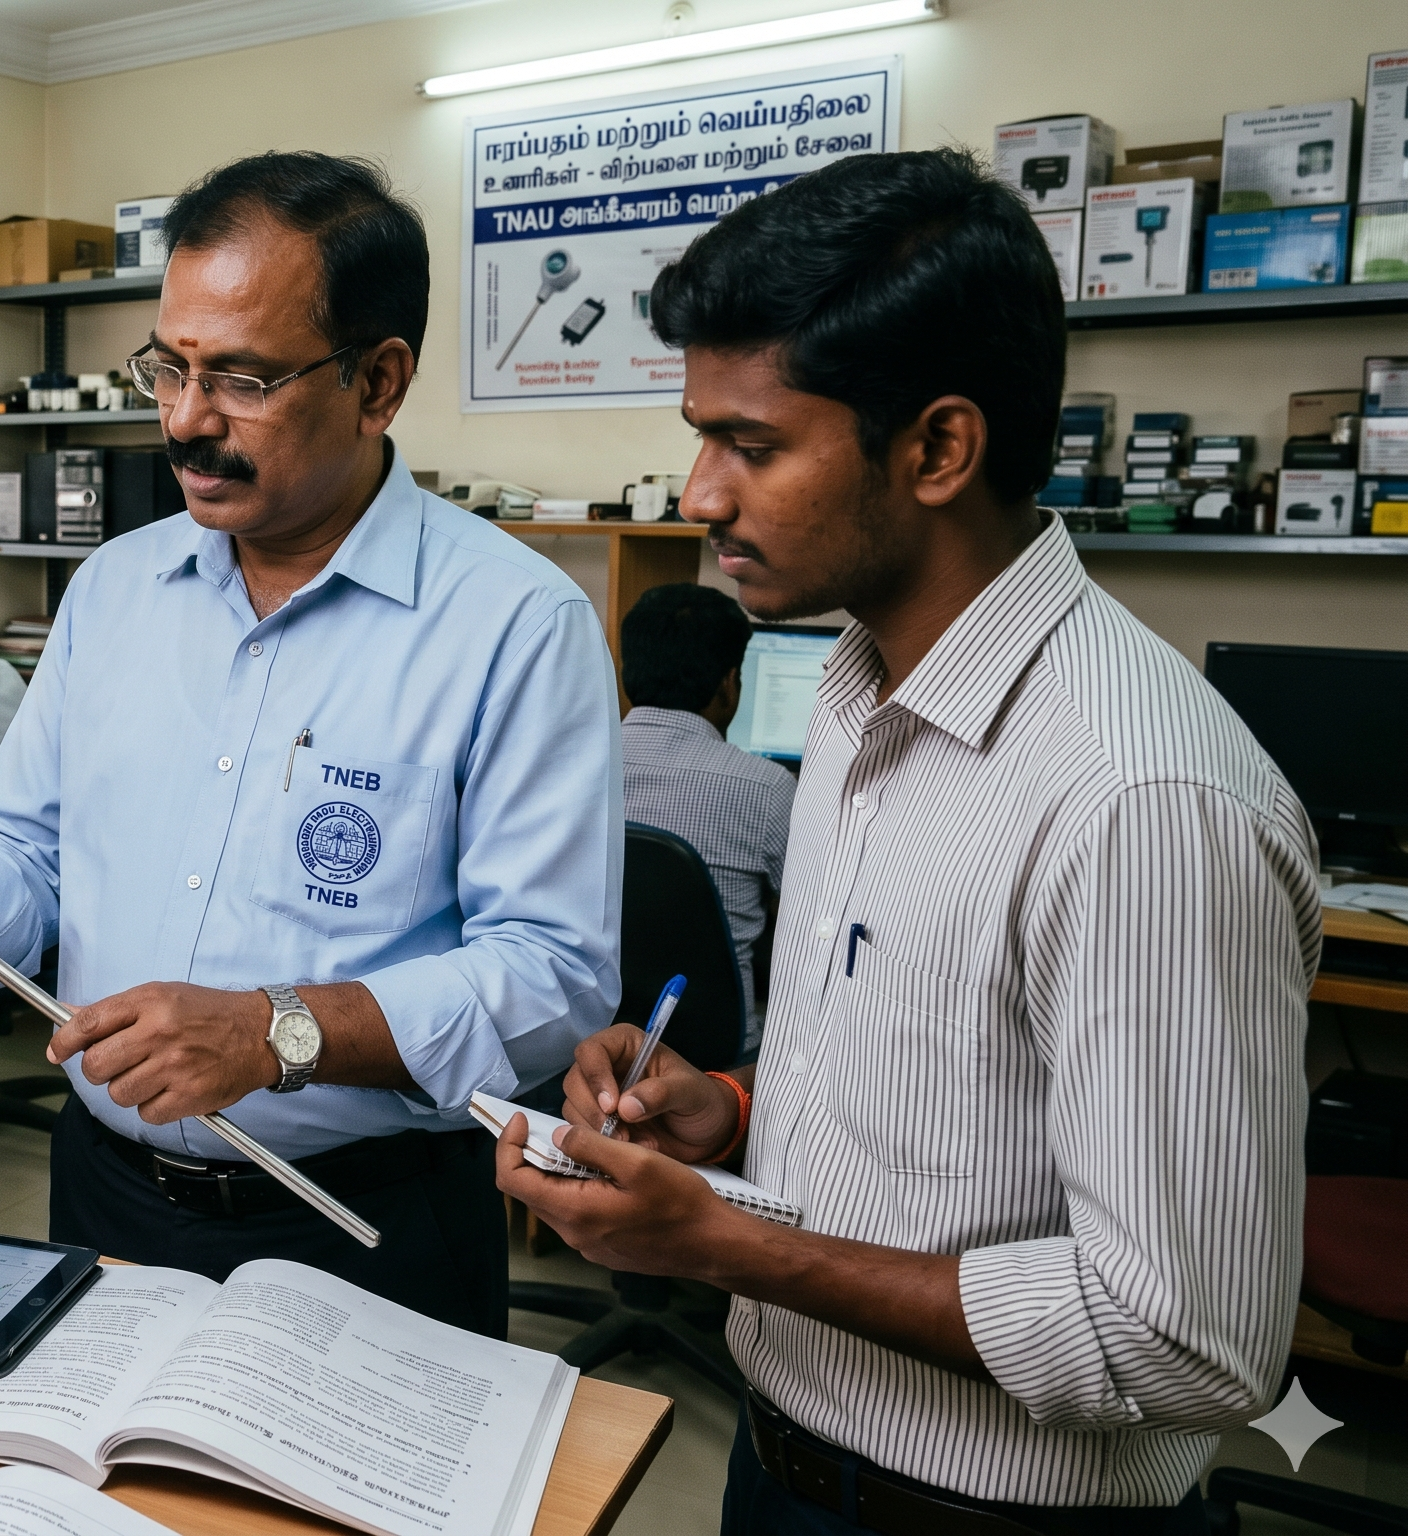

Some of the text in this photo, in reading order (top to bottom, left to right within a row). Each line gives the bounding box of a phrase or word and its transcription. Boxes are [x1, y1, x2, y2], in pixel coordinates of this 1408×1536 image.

[485, 124, 590, 164] ஈரப்பதம்
[596, 110, 692, 151] மற்றும்
[600, 154, 699, 184] விற்பனை
[704, 135, 789, 173] மற்றும்
[795, 132, 873, 157] சேவை
[493, 206, 555, 234] TNAU
[559, 191, 683, 229] அங்கீகாரம்
[321, 764, 381, 791] TNEB
[305, 884, 358, 908] TNEB
